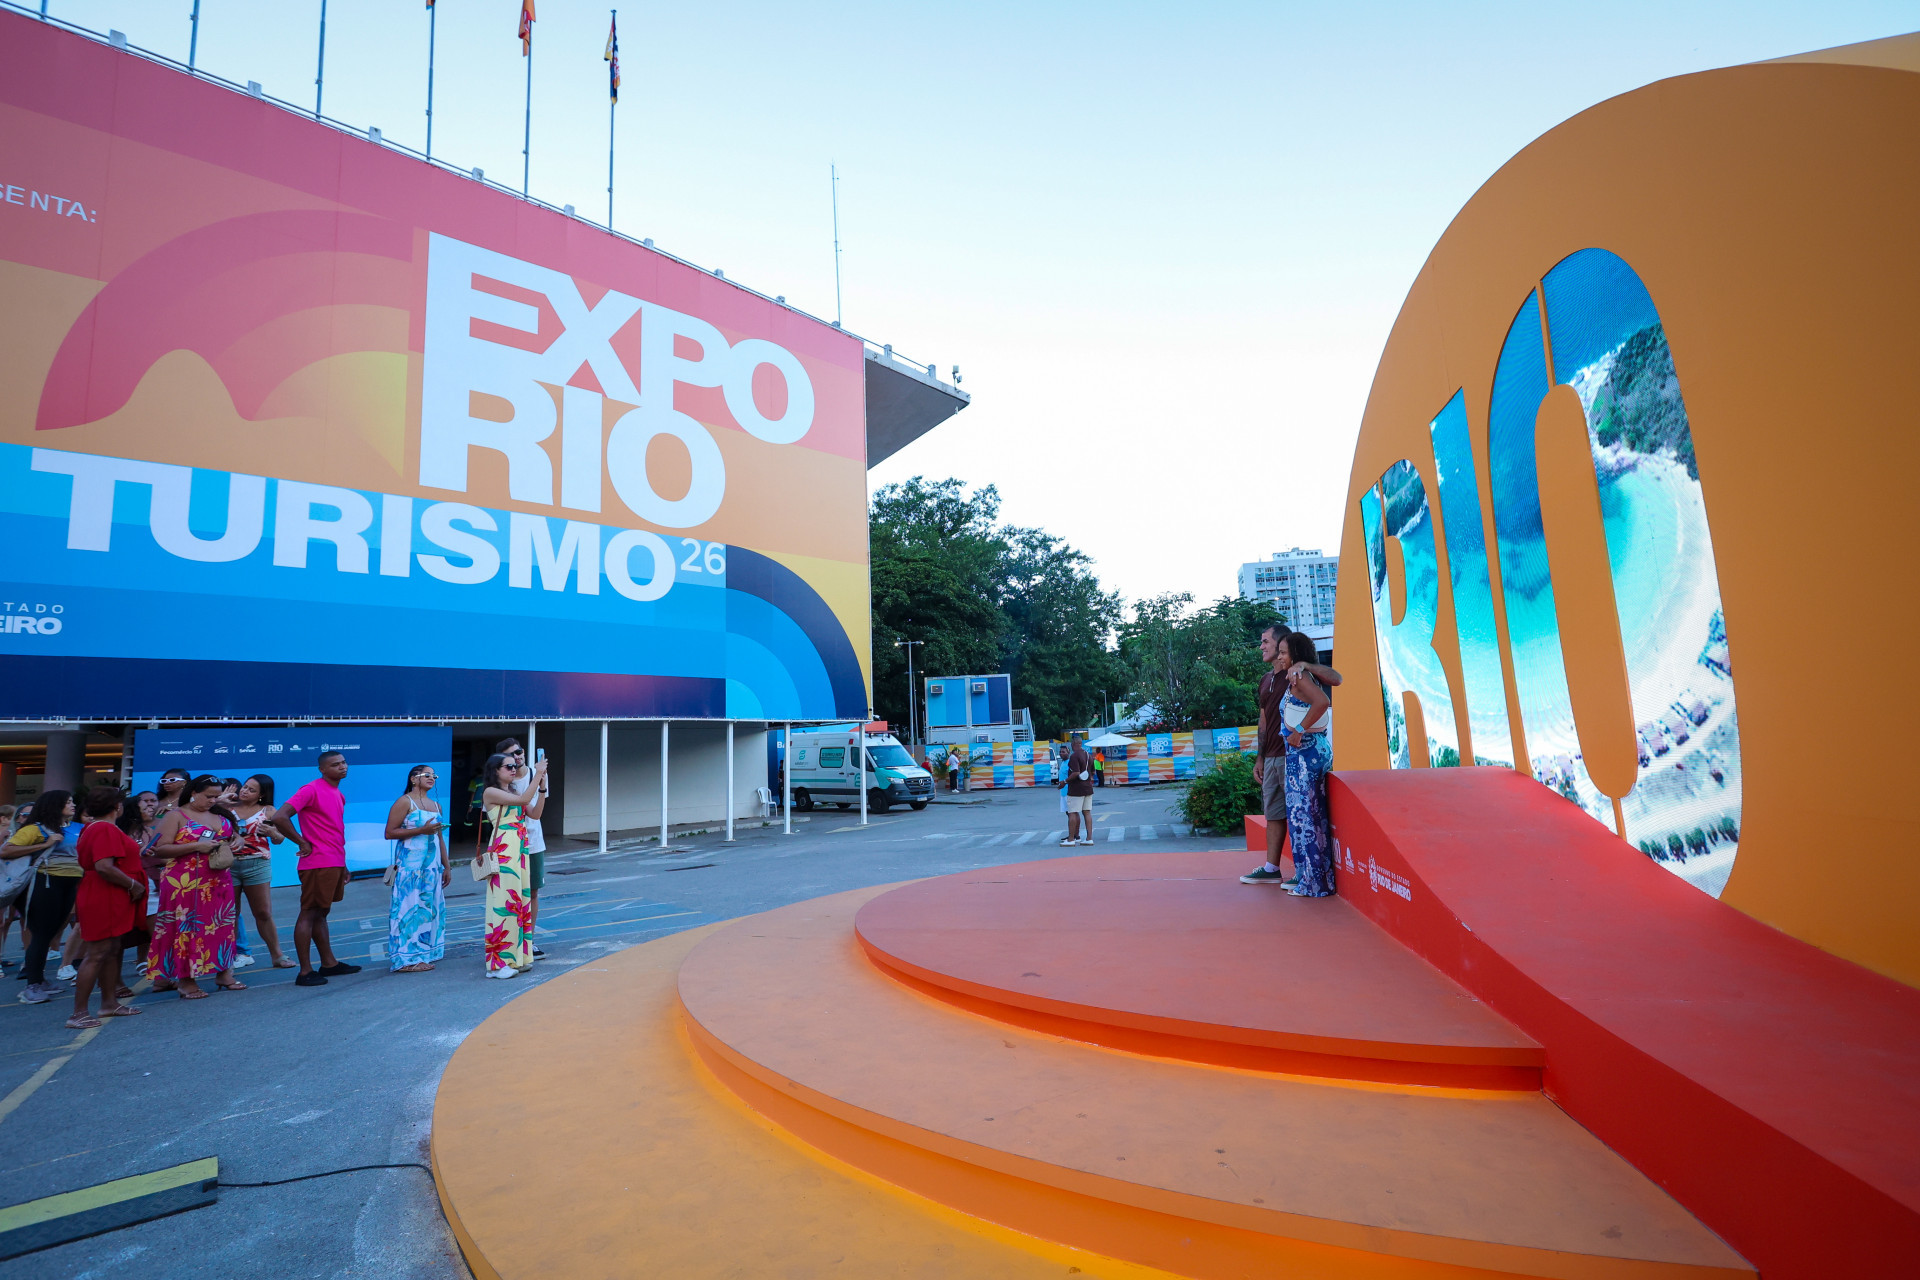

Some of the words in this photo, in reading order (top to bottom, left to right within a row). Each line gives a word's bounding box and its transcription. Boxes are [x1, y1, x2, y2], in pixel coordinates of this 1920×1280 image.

[0, 183, 96, 223] ENTA:
[422, 231, 815, 445] EXPO
[31, 447, 676, 602] TURISMO
[680, 537, 727, 576] 26
[419, 376, 726, 529] RIO
[1360, 247, 1743, 901] RIO
